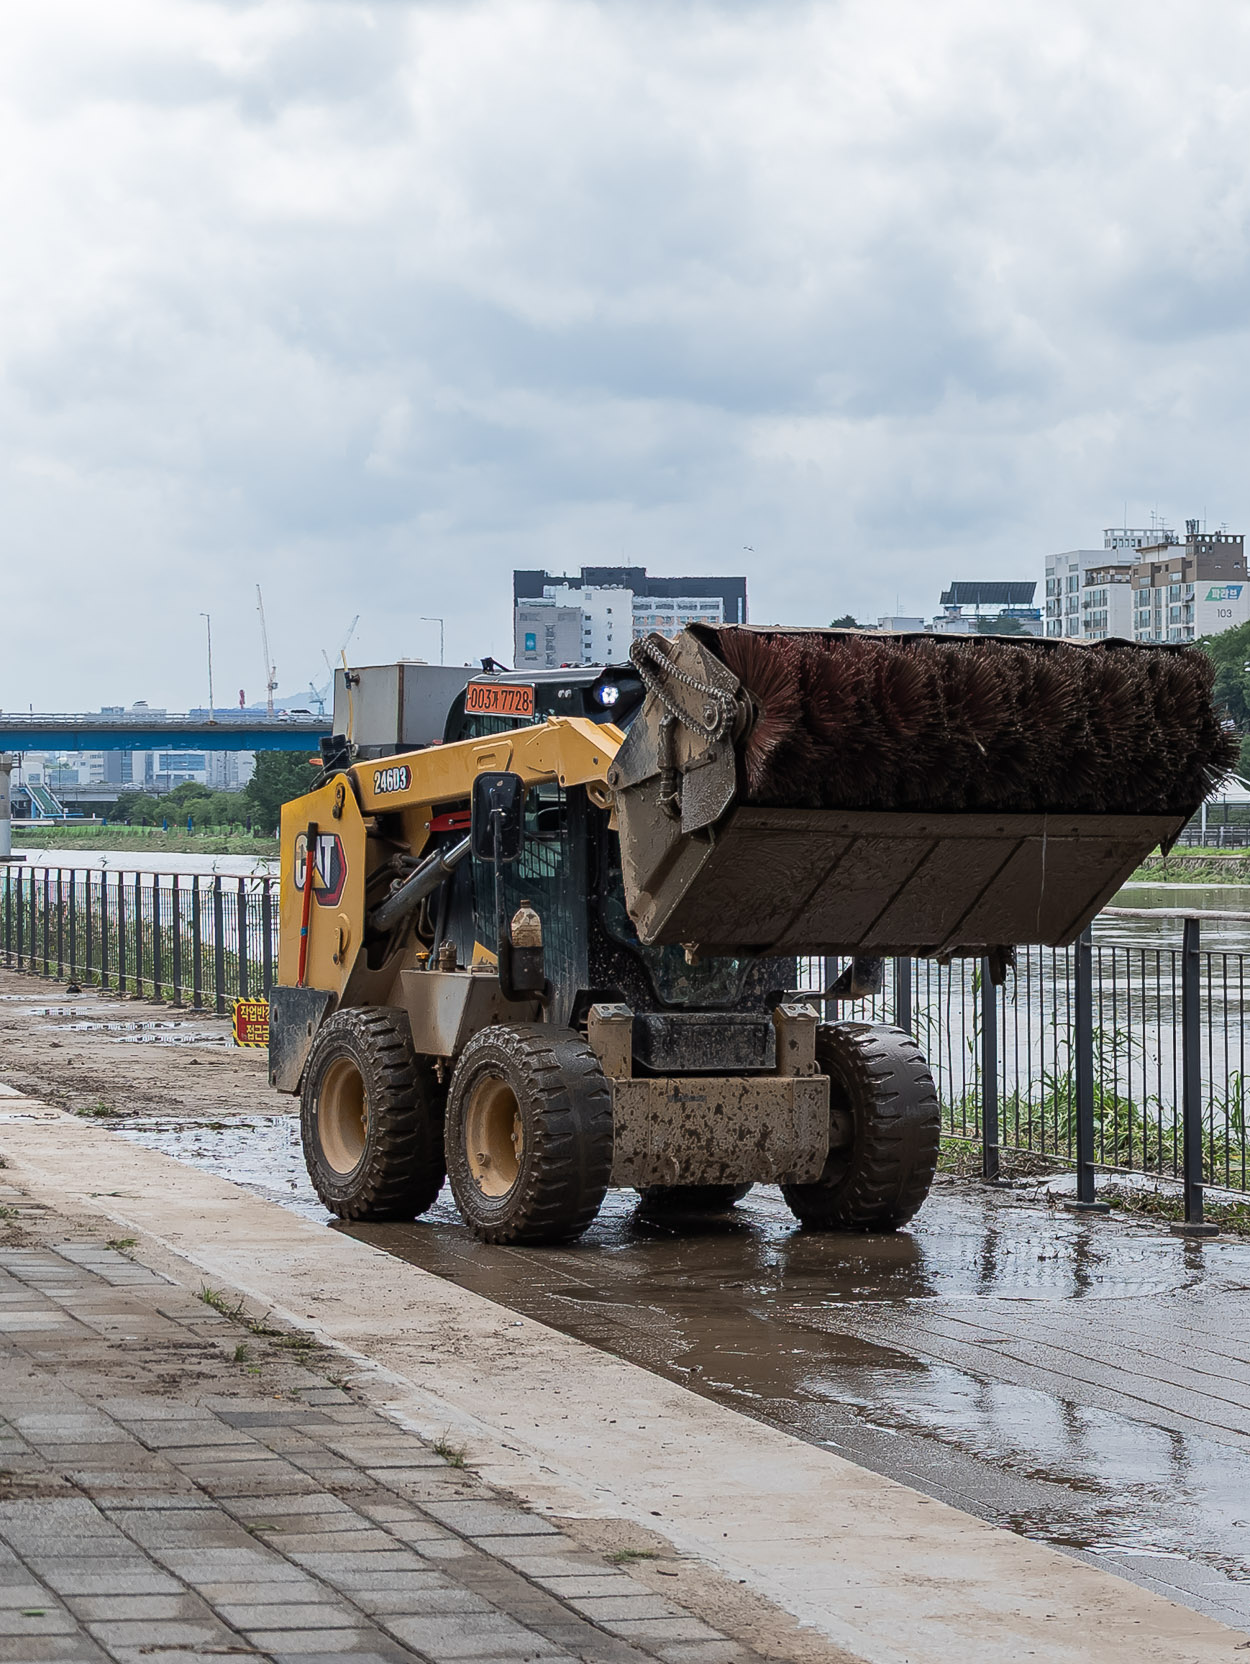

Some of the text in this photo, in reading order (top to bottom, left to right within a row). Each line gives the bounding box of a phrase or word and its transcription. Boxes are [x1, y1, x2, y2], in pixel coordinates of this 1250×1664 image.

[1216, 608, 1232, 618] 103
[501, 690, 530, 711] 7728
[374, 766, 407, 795] 246D3
